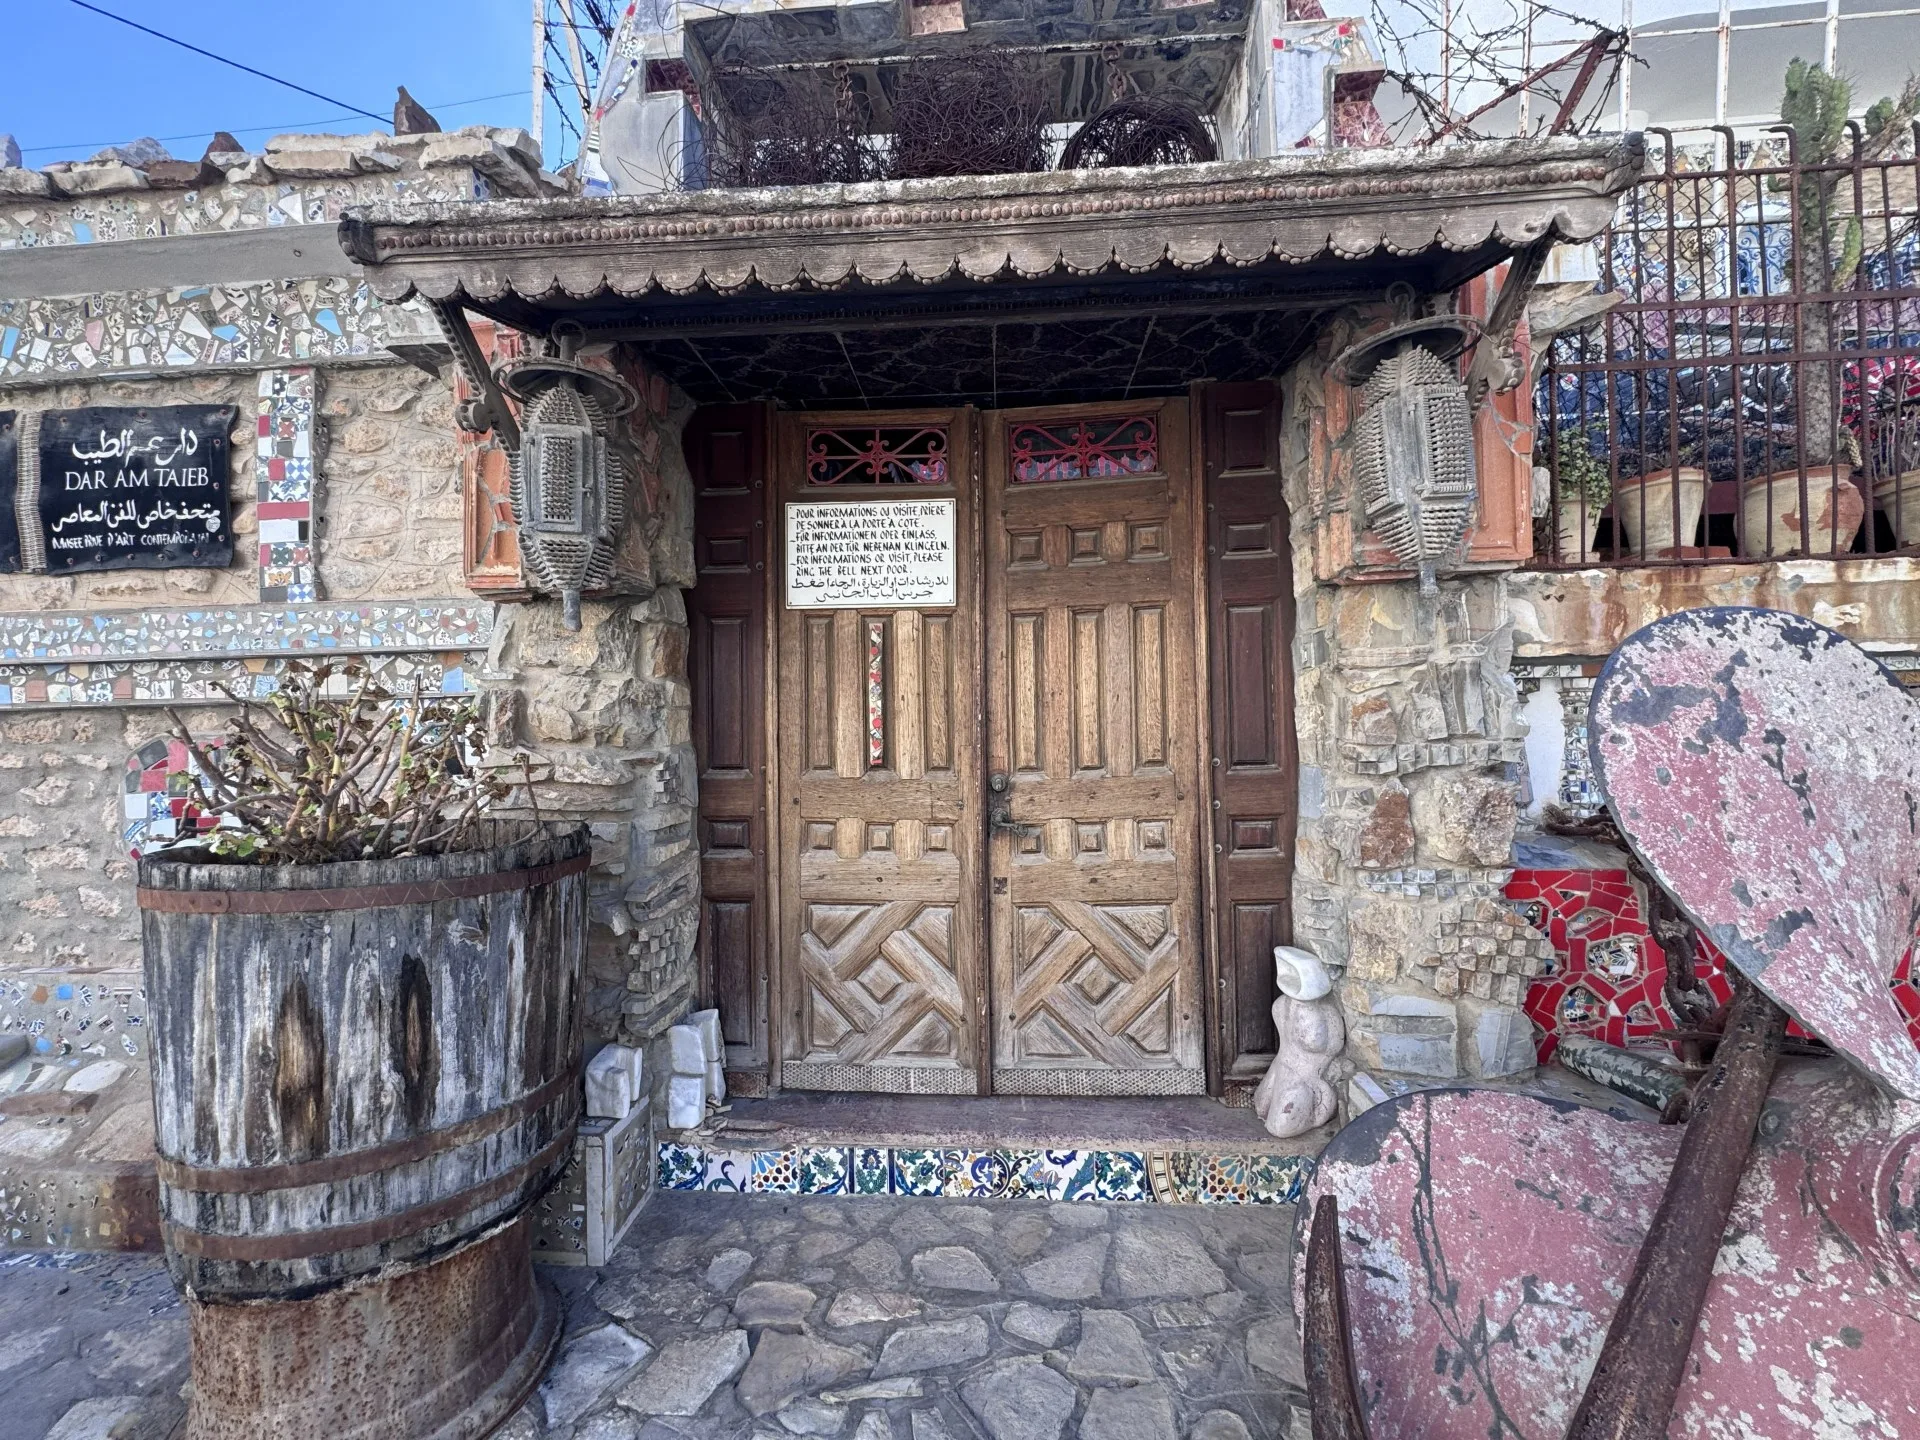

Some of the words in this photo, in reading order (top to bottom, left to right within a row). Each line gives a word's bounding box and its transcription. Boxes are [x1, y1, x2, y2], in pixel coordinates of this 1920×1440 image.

[72, 429, 134, 466] الطيب
[125, 435, 164, 468] عم
[155, 427, 198, 466] دار
[64, 470, 108, 491] DAR
[114, 469, 149, 488] AM
[154, 467, 209, 488] TAIEB
[51, 500, 108, 532] المعاصر
[106, 498, 137, 529] للفن
[136, 500, 177, 529] خاص
[175, 501, 221, 520] متحف
[796, 508, 815, 519] POUR
[880, 506, 890, 517] OU
[796, 520, 805, 531] DE
[807, 519, 840, 530] SONNER
[849, 519, 860, 529] LA
[862, 518, 887, 529] PORTE
[52, 536, 84, 550] MUSEE
[107, 532, 136, 547] D'ART
[880, 529, 899, 540] ODER
[816, 543, 828, 553] AN
[829, 542, 844, 553] DER
[846, 540, 860, 552] TÜR
[863, 541, 901, 552] NEBENAN
[796, 555, 809, 565] FOR
[874, 553, 885, 563] OR
[913, 552, 944, 563] PLEASE
[818, 566, 832, 576] THE
[837, 565, 857, 576] BELL
[861, 565, 884, 576] NEXT
[813, 588, 869, 604] الجانبي
[869, 587, 898, 600] الباب
[897, 589, 934, 600] جرس
